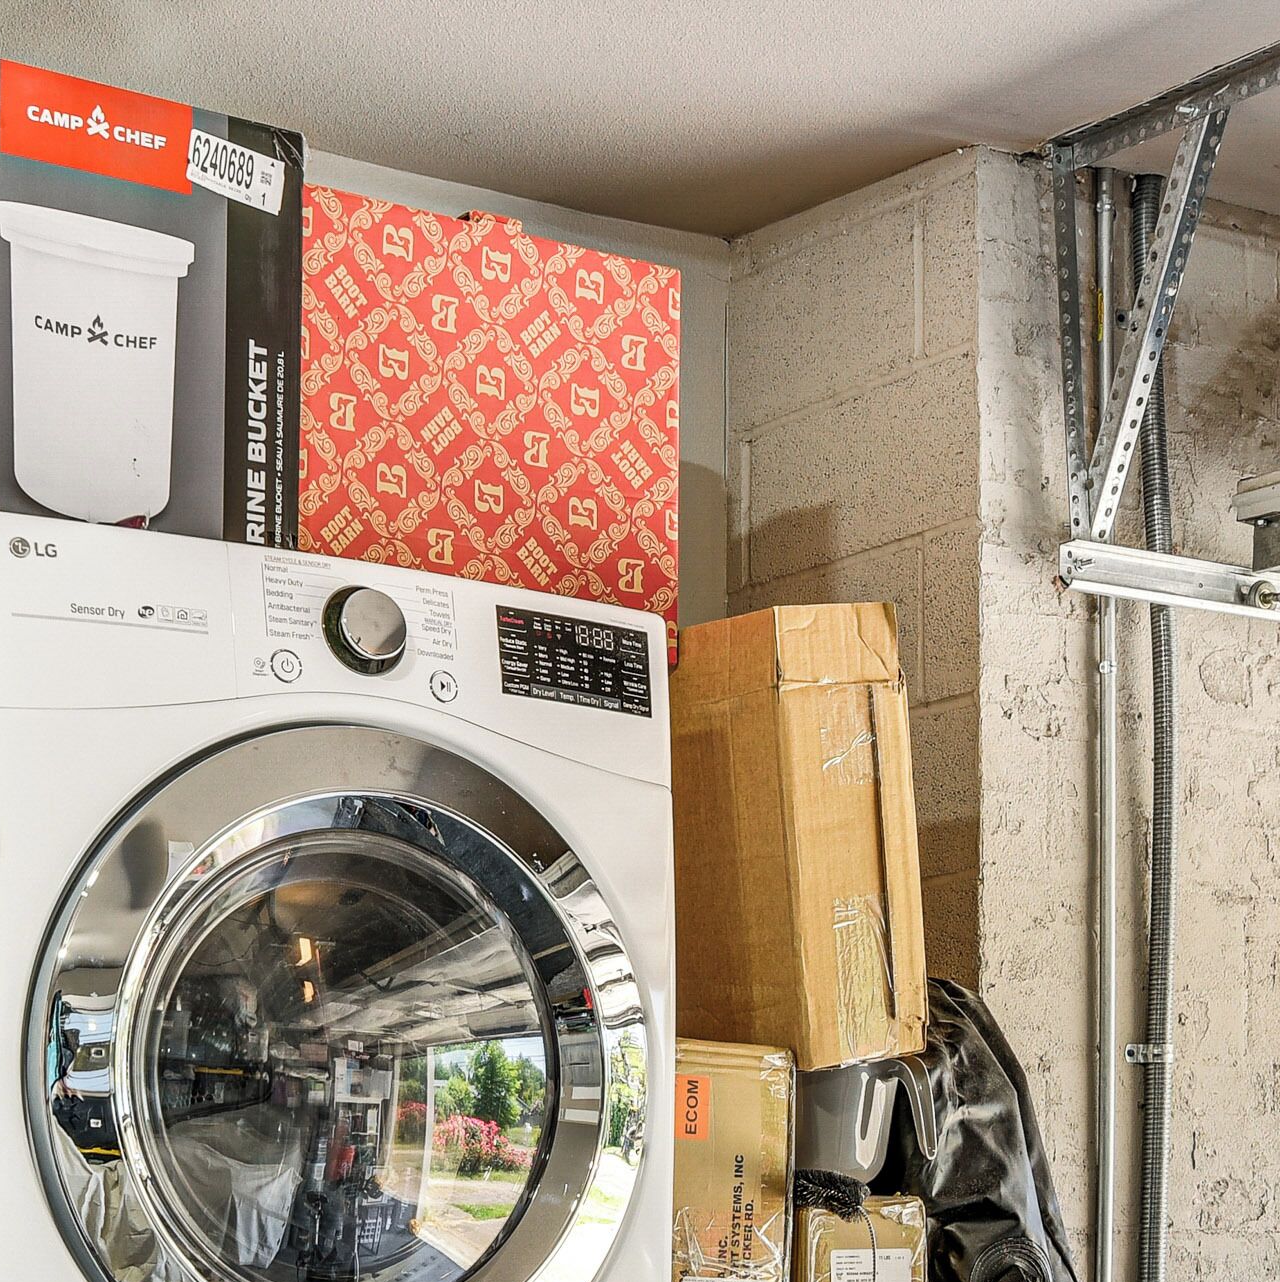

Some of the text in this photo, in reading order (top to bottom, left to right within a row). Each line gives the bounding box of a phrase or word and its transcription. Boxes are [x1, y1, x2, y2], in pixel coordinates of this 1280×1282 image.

[26, 105, 167, 150] CAMP CHEF
[191, 135, 254, 190] 6240689
[324, 273, 359, 319] BARN
[334, 264, 368, 308] BOOT
[34, 315, 157, 349] CAMP CHEF
[519, 310, 553, 346] BOOT
[528, 323, 562, 359] BARN
[246, 338, 269, 545] RINE BUCKET
[420, 406, 455, 443] BARN
[431, 419, 463, 456] BOOT
[610, 451, 644, 490] BOOT
[619, 440, 654, 480] BARN
[320, 505, 353, 542] BOOT
[329, 519, 364, 555] BARN
[34, 542, 58, 558] LG
[516, 547, 550, 587] BARN
[524, 537, 558, 576] BOOT
[264, 564, 288, 573] Normal
[265, 576, 303, 588] Heavy Duty
[265, 589, 293, 600] Bedding
[267, 602, 310, 613] Antibacterial
[415, 585, 449, 598] Perm Press
[422, 598, 449, 609] Delicates
[70, 603, 125, 620] Sensor Dry
[268, 615, 287, 623] Steam
[430, 609, 451, 620] Towels
[269, 629, 290, 638] Steam
[421, 624, 452, 636] Speed Dry
[442, 640, 452, 649] Dry
[417, 648, 454, 661] Downloaded
[685, 1079, 699, 1135] ECOM
[734, 1154, 744, 1178] INC
[731, 1181, 744, 1248] SYSTEMS,
[744, 1199, 754, 1223] RD.
